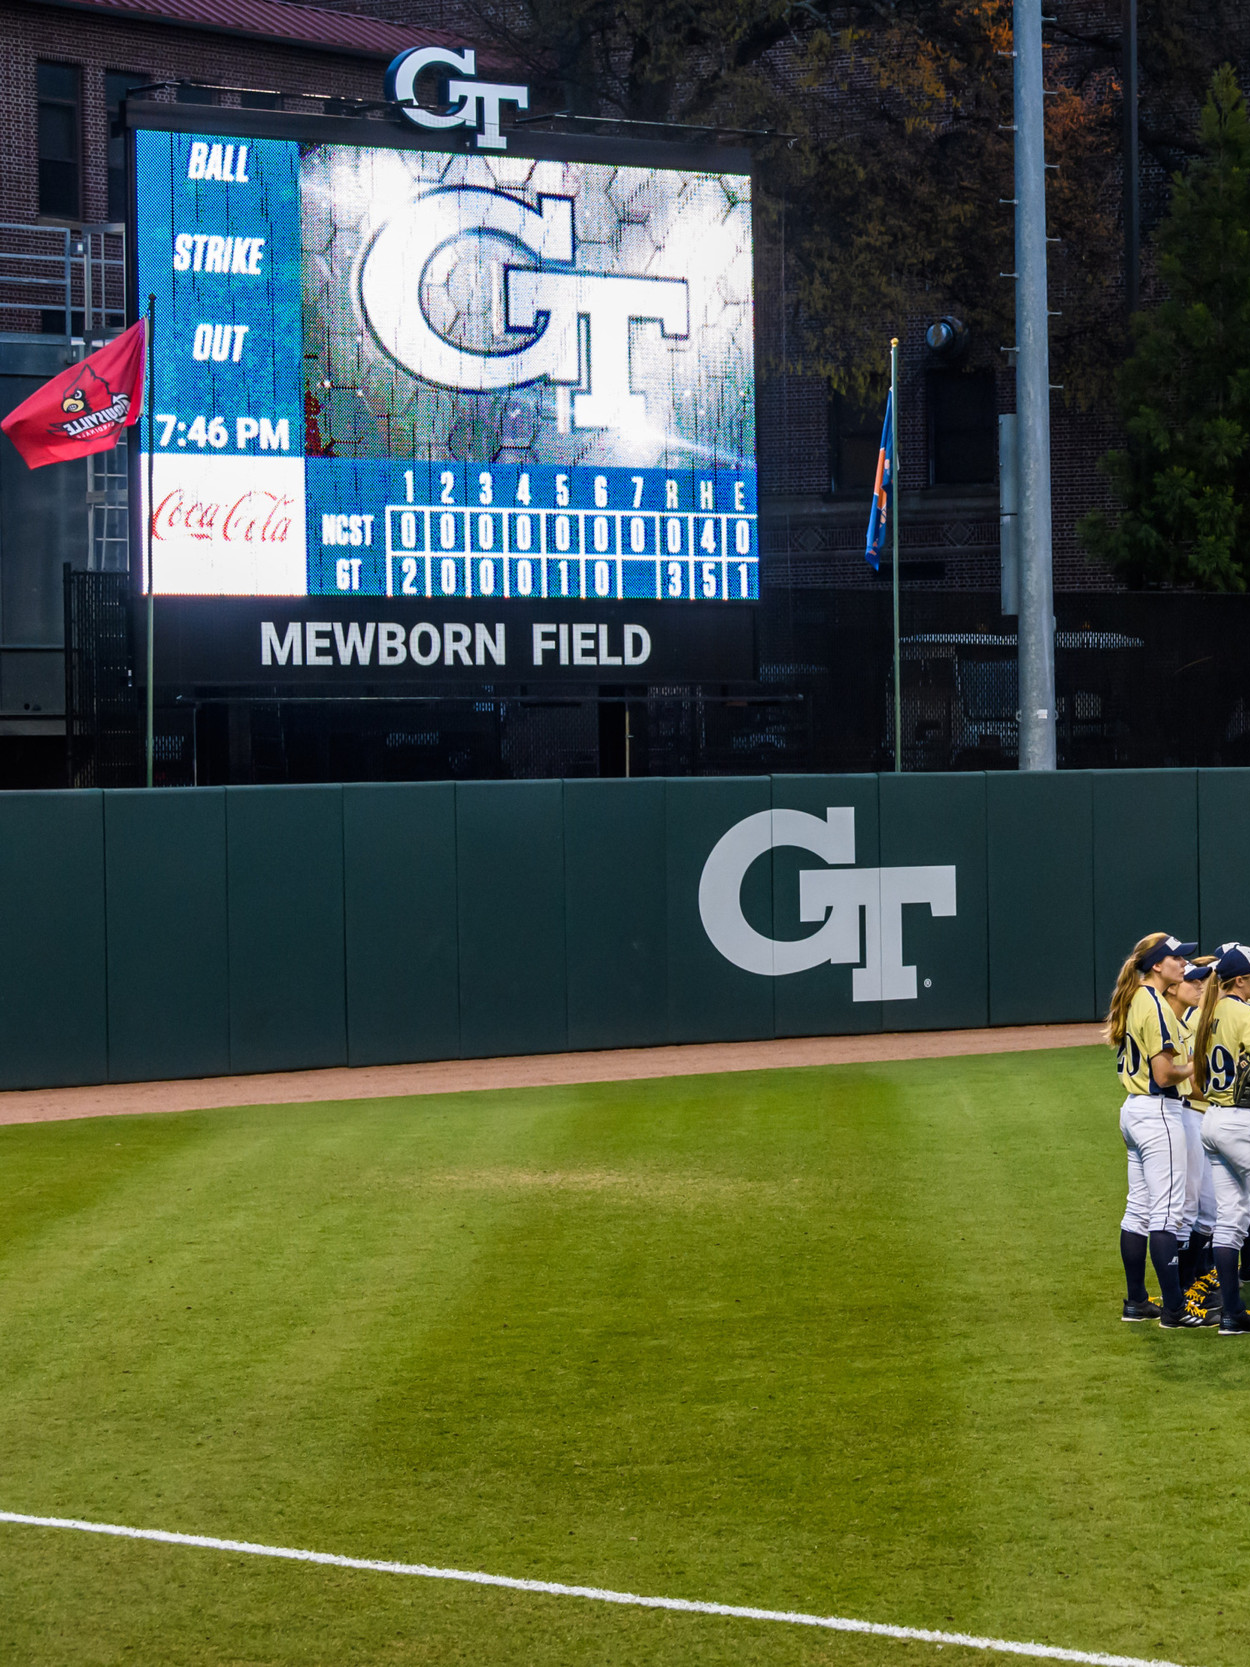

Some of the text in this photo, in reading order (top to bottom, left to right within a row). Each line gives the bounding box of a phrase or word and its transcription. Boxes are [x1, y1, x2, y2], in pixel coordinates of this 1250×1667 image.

[387, 46, 529, 149] GT
[187, 141, 249, 183] BALL
[173, 233, 265, 275] STRIKE
[358, 184, 691, 431] GT
[192, 324, 249, 362] OUT
[155, 414, 290, 451] 7:46 PM
[403, 470, 745, 511] 1 2 3 4 5 6 7 R H E
[321, 512, 750, 555] NCST 0 0 0 0 0 0 0 0 4 0
[335, 557, 748, 598] GT 2 0 0 0 1 0 3 5 1
[260, 621, 652, 666] MEWBORN FIELD
[698, 806, 957, 1002] GT
